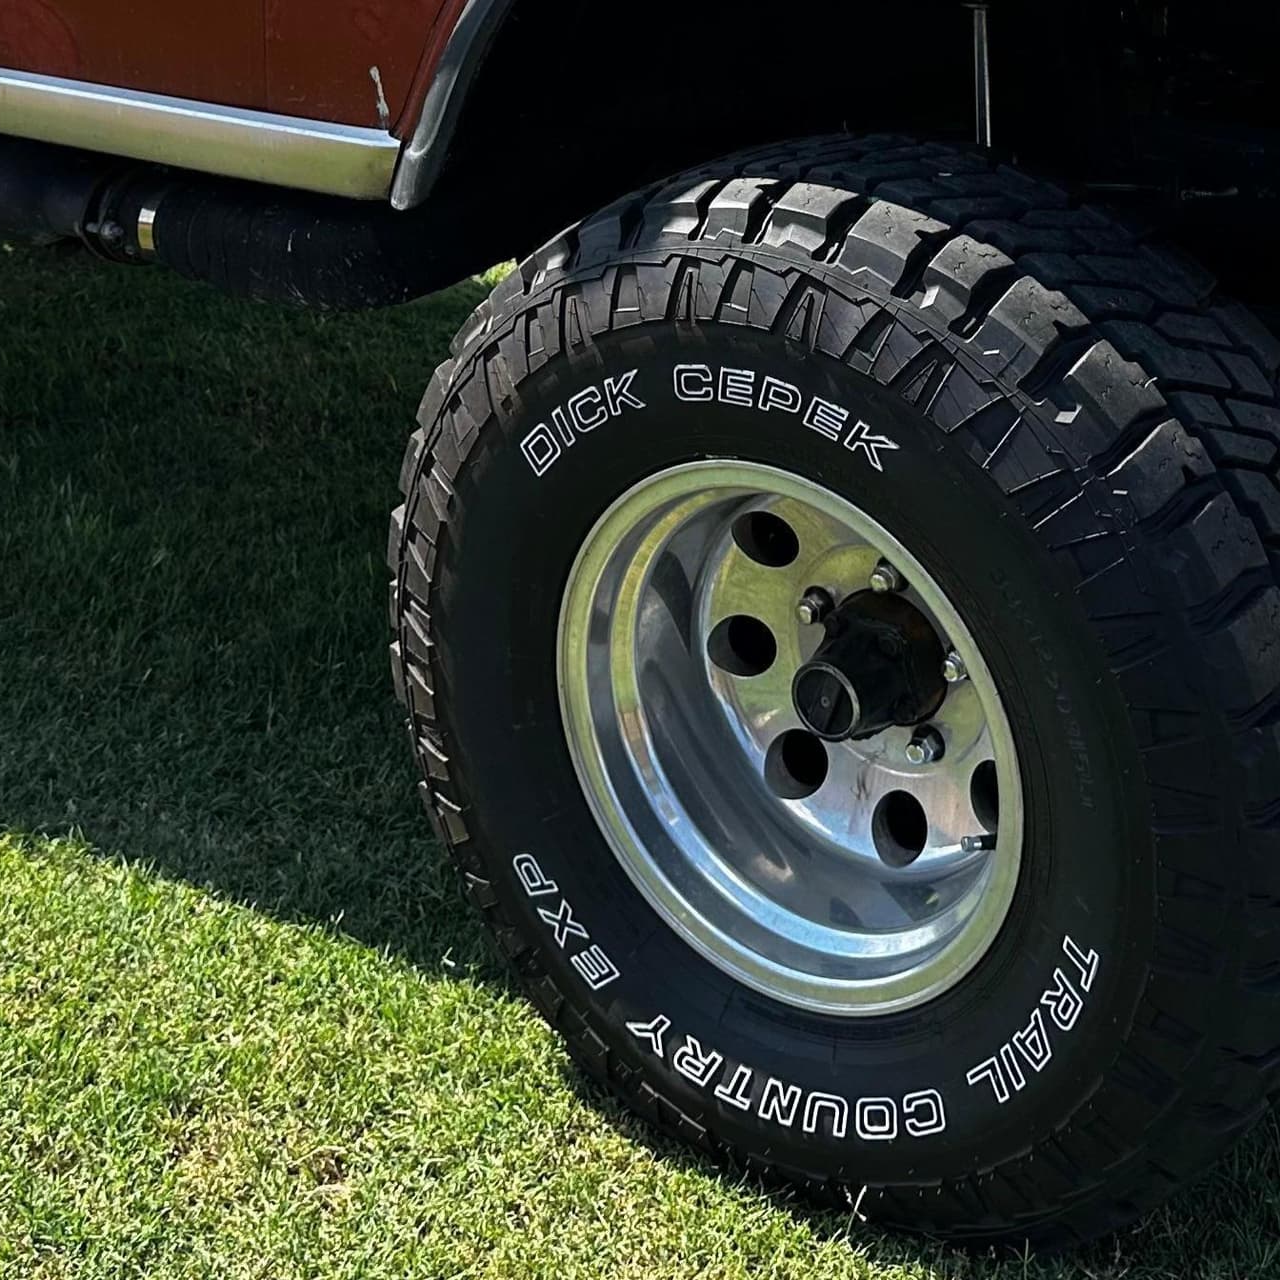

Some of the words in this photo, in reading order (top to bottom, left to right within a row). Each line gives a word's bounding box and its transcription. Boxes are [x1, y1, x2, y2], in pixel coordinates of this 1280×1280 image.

[520, 368, 647, 477] DICK
[672, 363, 901, 472] CEPEK
[512, 853, 620, 991] EXP
[626, 1014, 946, 1140] COUNTRY
[967, 935, 1100, 1103] TRAIL
